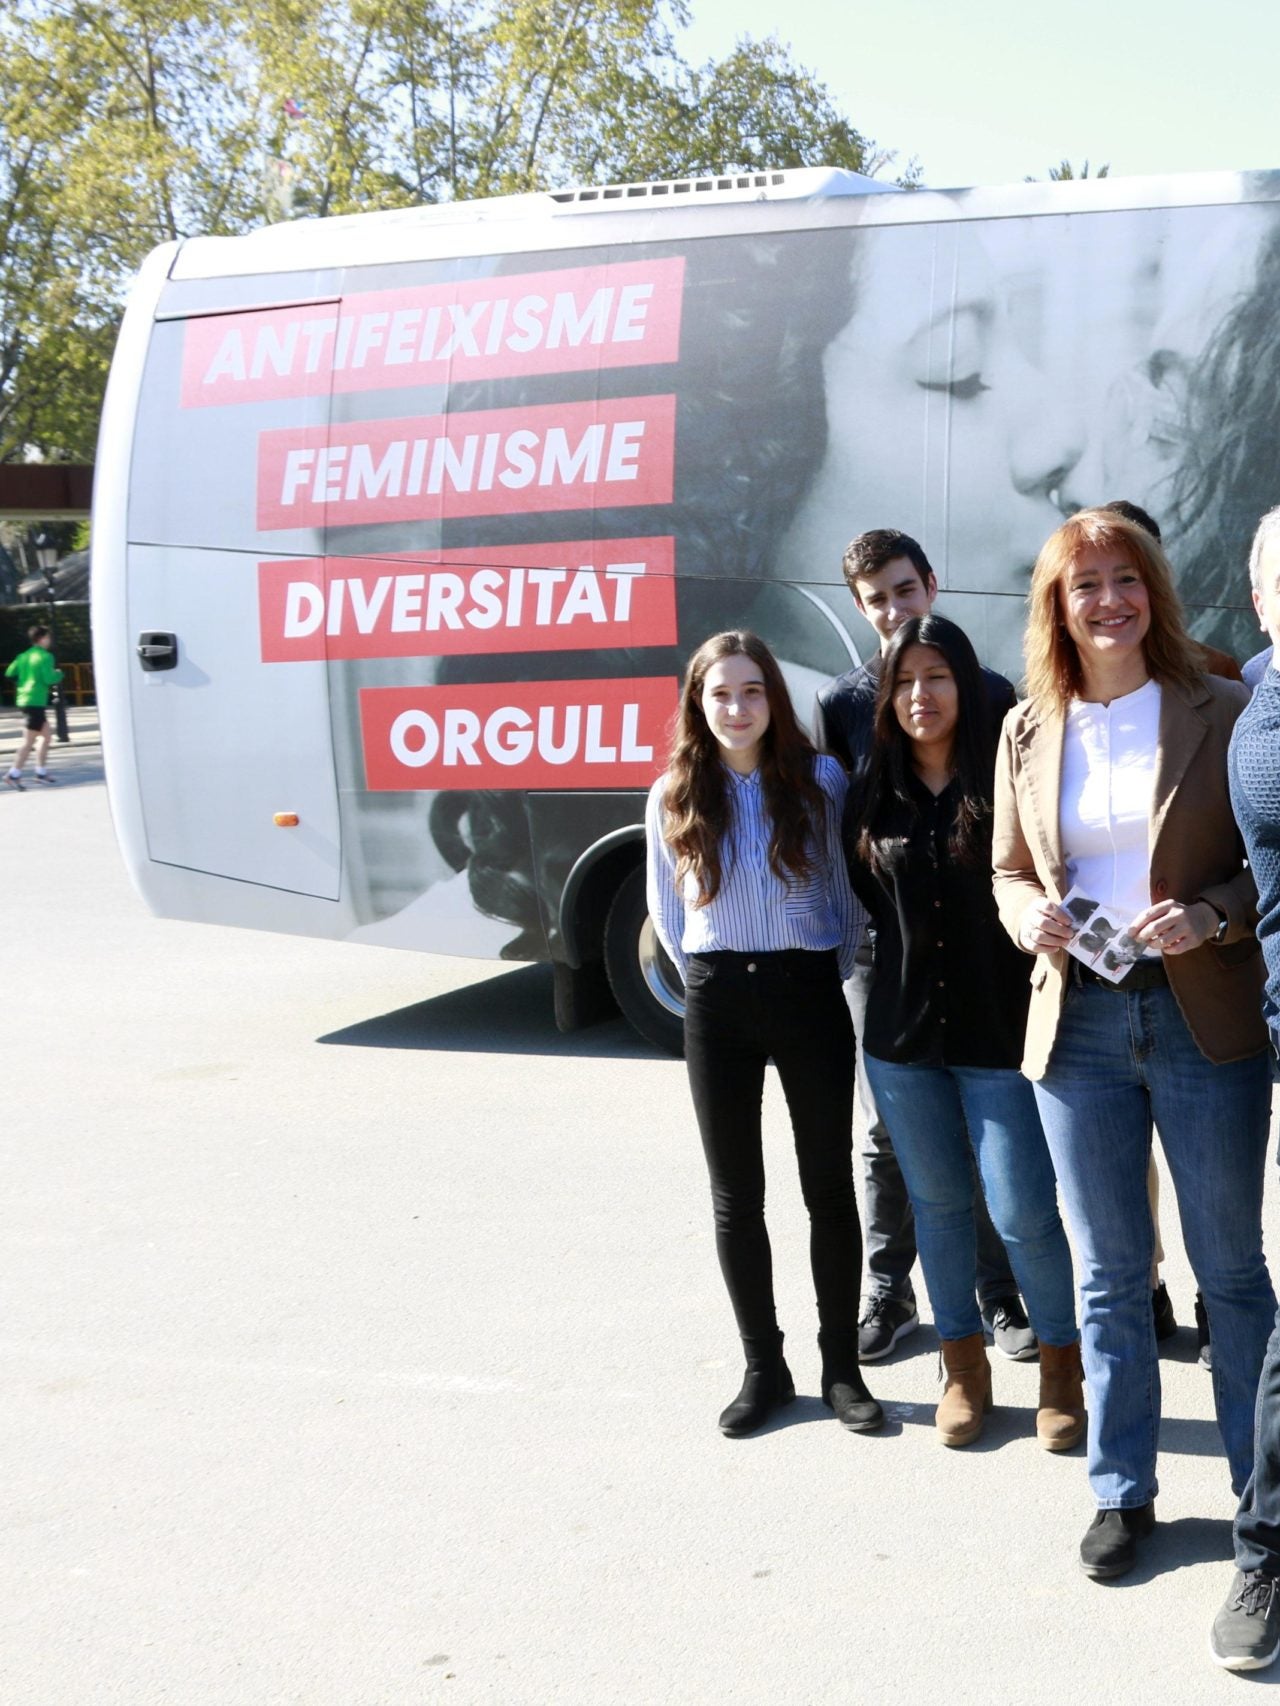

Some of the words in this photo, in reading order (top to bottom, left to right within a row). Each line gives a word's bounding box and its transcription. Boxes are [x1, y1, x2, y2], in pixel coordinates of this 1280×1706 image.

[203, 283, 655, 385] ANTIFEIXISME
[281, 420, 646, 506] FEMINISME
[284, 562, 646, 638] DIVERSITAT
[390, 704, 653, 767] ORGULL
